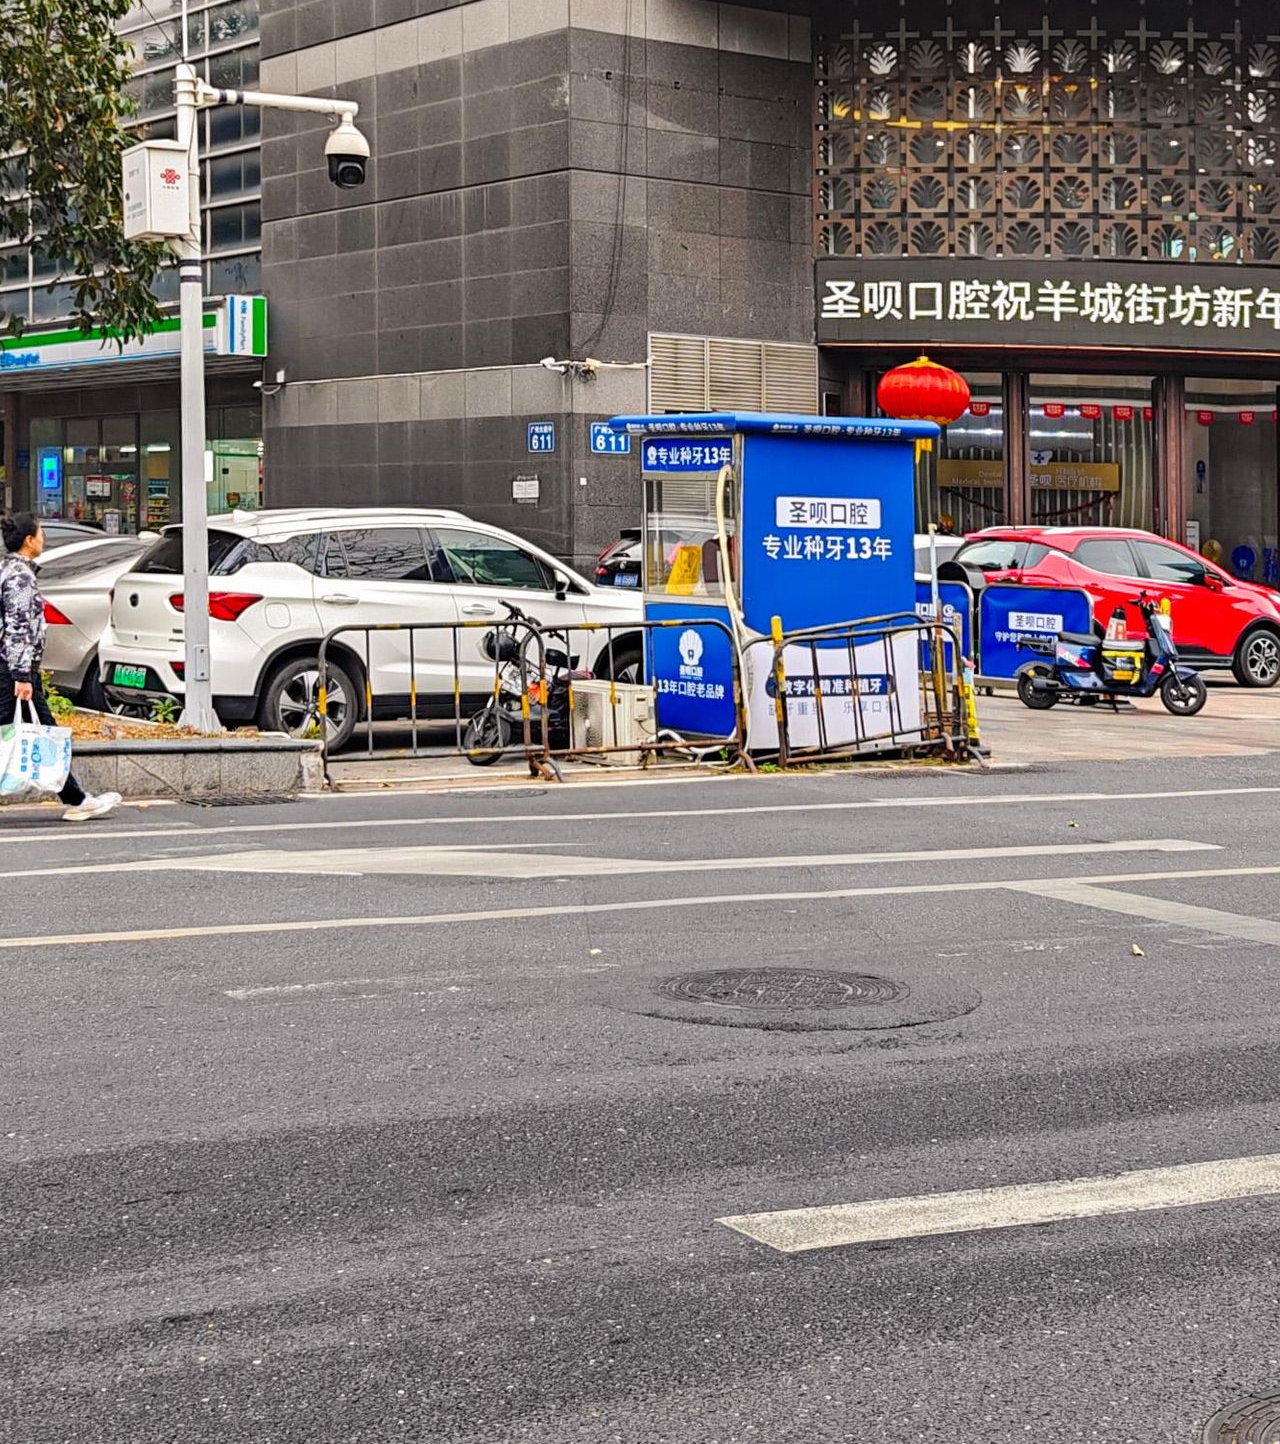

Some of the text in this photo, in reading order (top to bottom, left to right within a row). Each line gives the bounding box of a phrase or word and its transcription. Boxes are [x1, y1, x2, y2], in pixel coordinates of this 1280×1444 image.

[532, 435, 552, 449] 611
[596, 435, 626, 451] 611
[657, 446, 731, 465] 专业种牙13年
[789, 501, 869, 526] 圣呗口腔
[762, 534, 893, 562] 专业种牙13年
[1014, 614, 1057, 630] 圣呗口腔
[657, 678, 725, 700] 13年口腔老品牌
